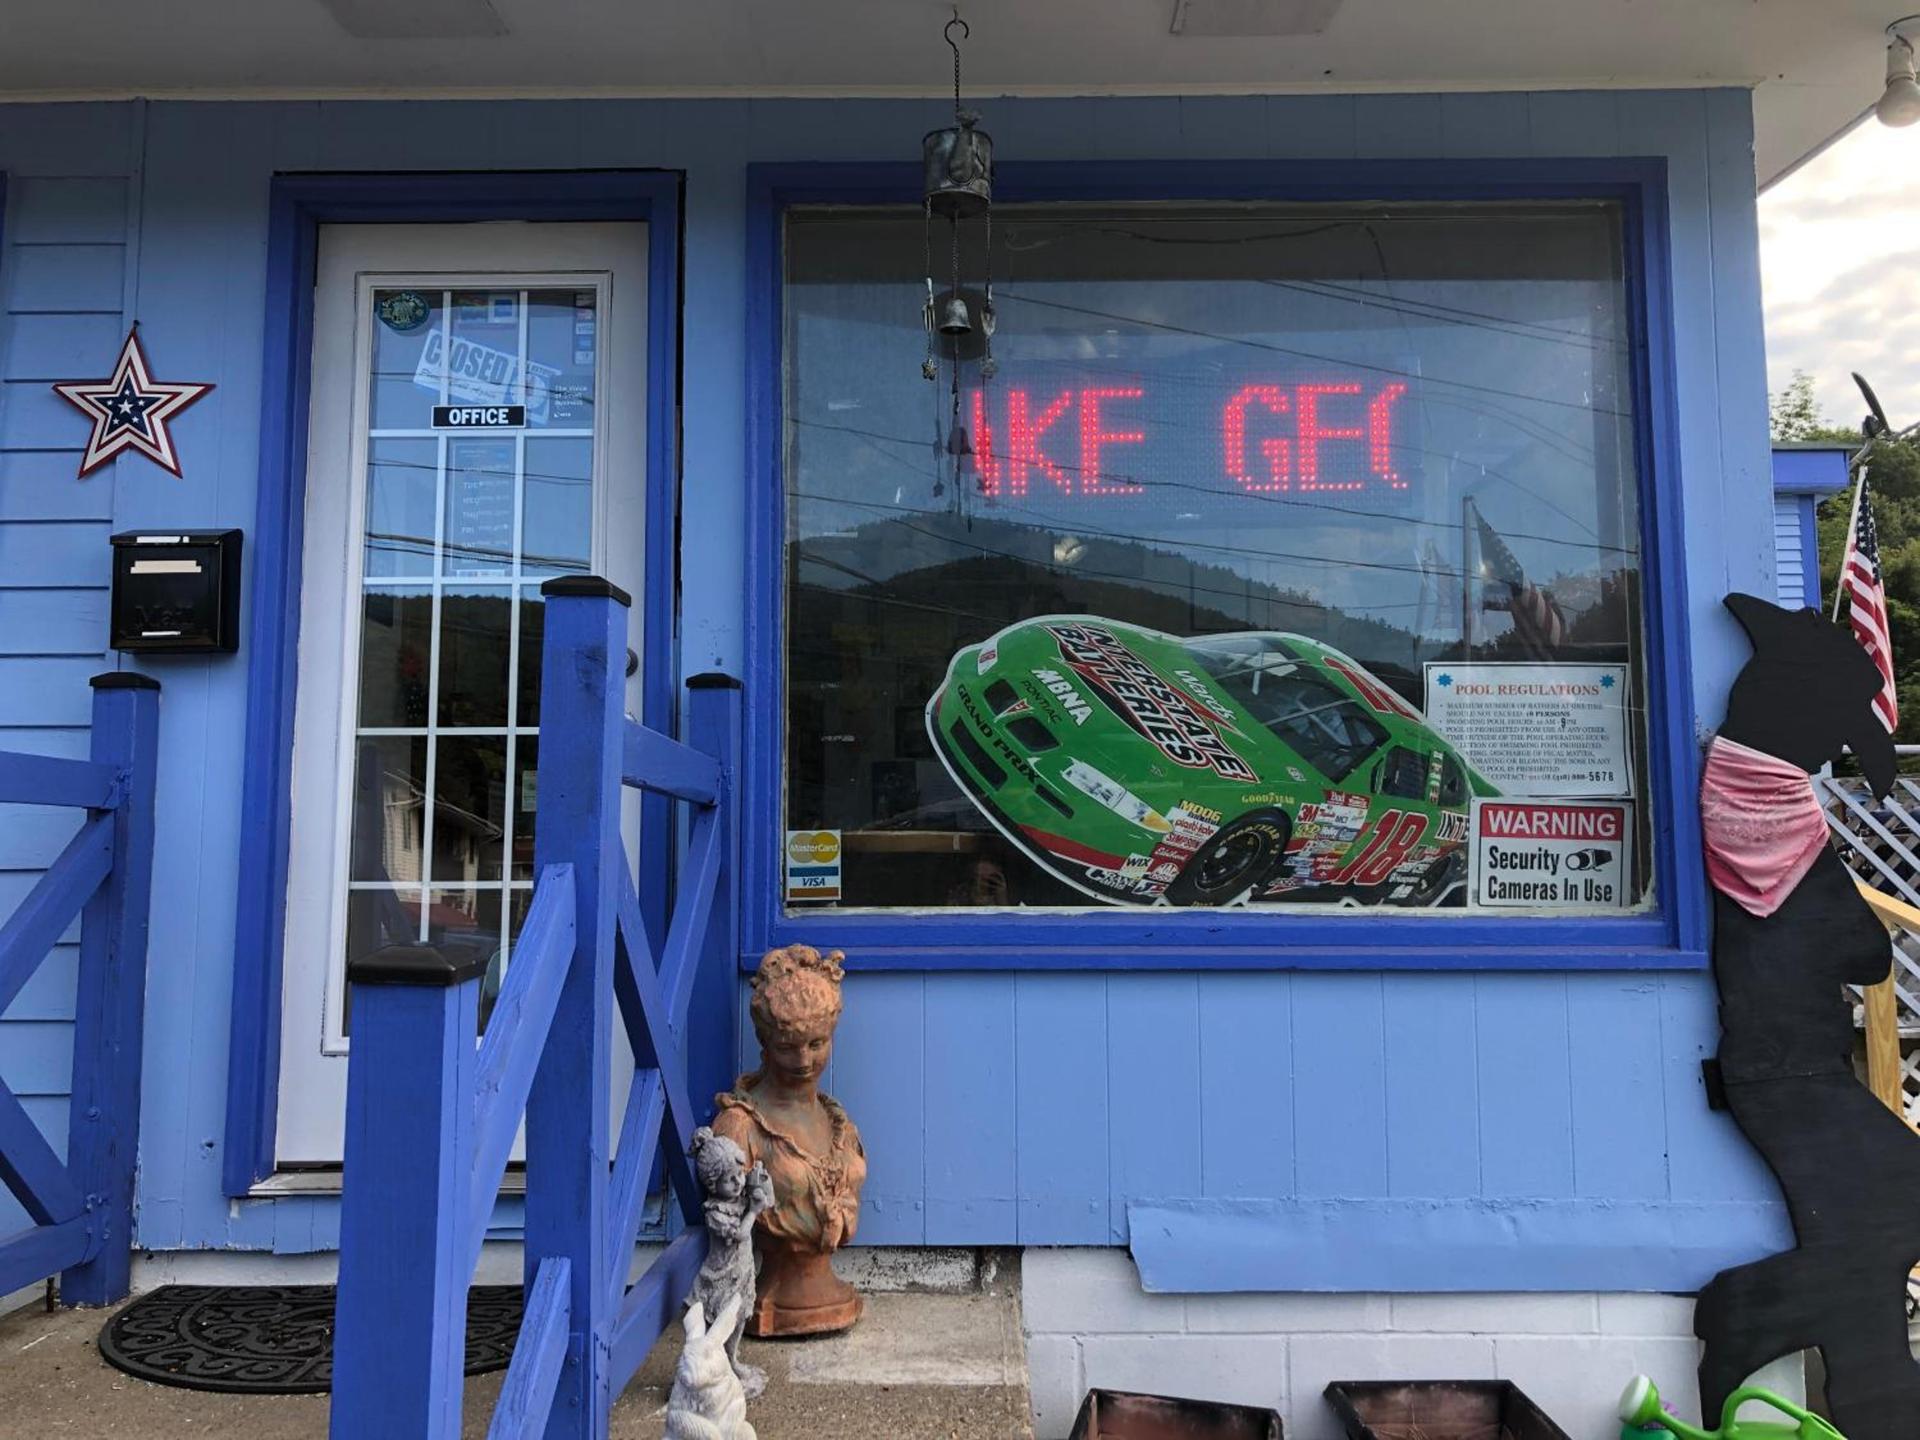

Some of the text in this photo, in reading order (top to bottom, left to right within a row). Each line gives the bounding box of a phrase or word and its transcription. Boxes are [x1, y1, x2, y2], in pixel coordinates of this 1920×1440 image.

[425, 335, 509, 383] COSED
[449, 408, 510, 425] OFFICE
[1021, 680, 1062, 724] PONTIAC
[1031, 669, 1093, 726] MBNA
[1050, 626, 1206, 767] BATTERIES
[1076, 624, 1252, 777] INTERSTATE
[1456, 684, 1600, 696] POOL REGULATIONS
[957, 684, 1041, 783] GRAND PRIX
[1560, 717, 1567, 729] 9
[1180, 799, 1223, 821] MOOG
[1242, 792, 1296, 805] GOODYEAR
[1488, 809, 1617, 837] WARNING
[1331, 808, 1429, 885] 18
[1489, 845, 1560, 876] Security
[1126, 857, 1152, 868] WIX
[802, 877, 826, 887] VISA
[1488, 876, 1612, 902] Cameras In Use
